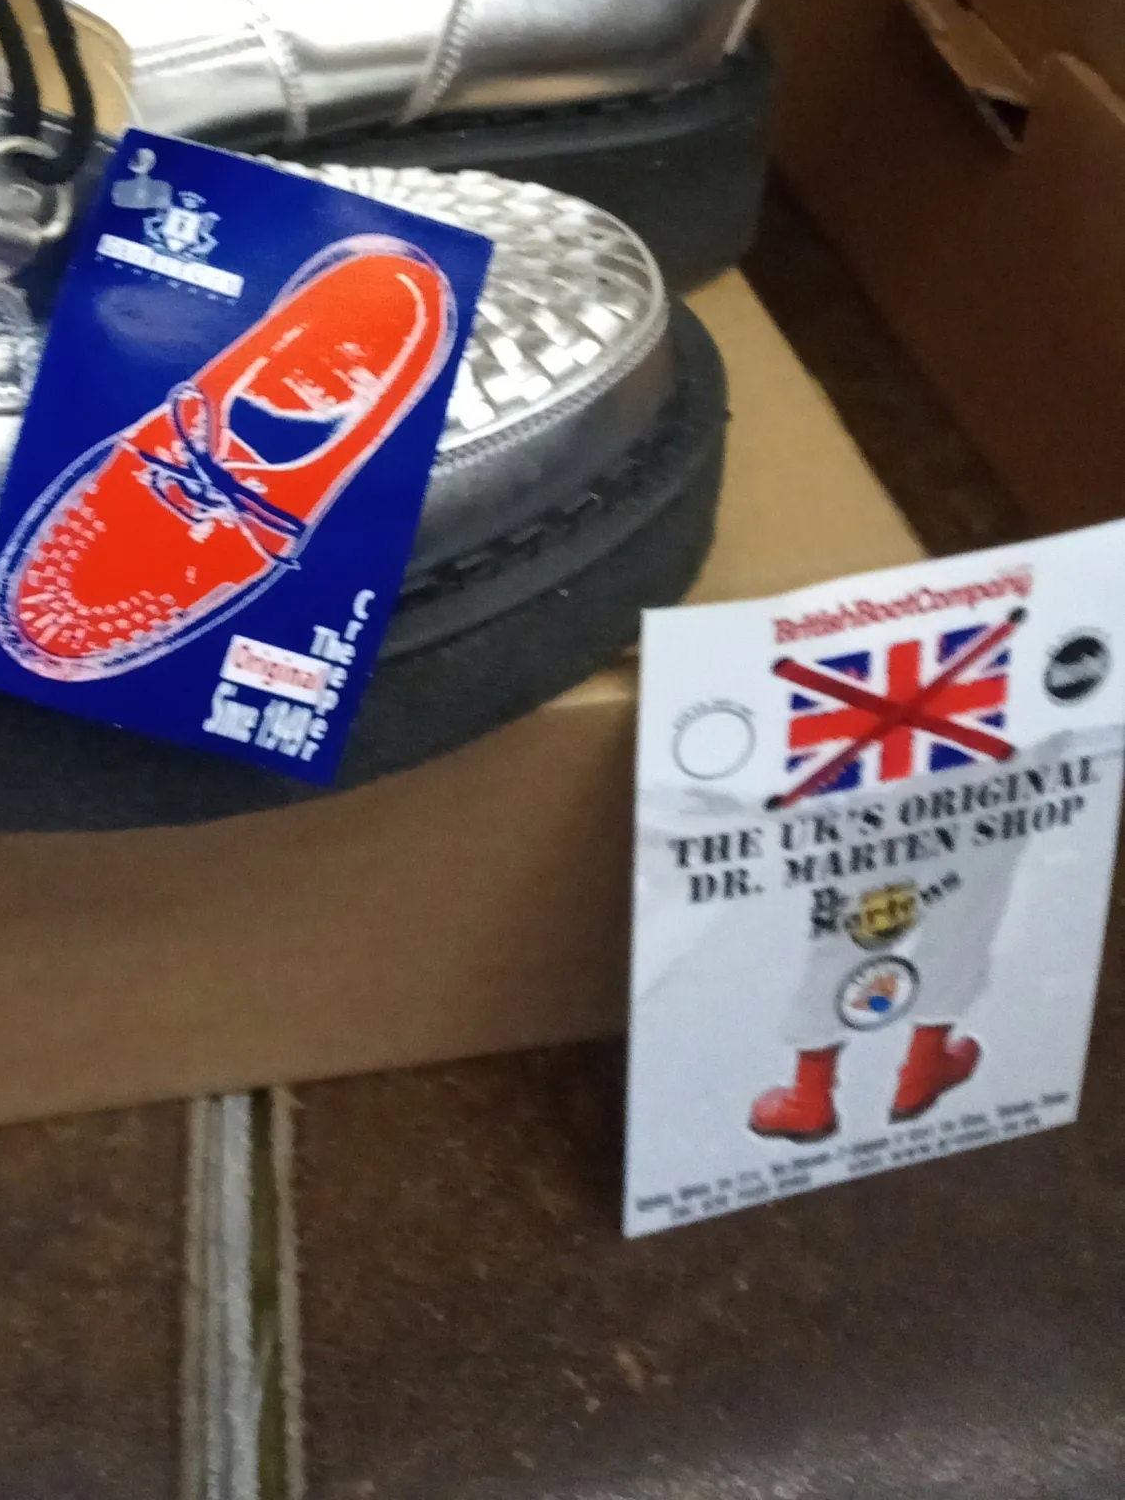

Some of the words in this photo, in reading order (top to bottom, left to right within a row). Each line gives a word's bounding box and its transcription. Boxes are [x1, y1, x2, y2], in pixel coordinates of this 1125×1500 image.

[669, 825, 764, 869] THE
[779, 802, 886, 853] UK'S
[897, 755, 1101, 829] ORIGINAL
[687, 869, 765, 905] DR.
[781, 825, 962, 890] MARTEN
[972, 793, 1086, 847] SHOP
